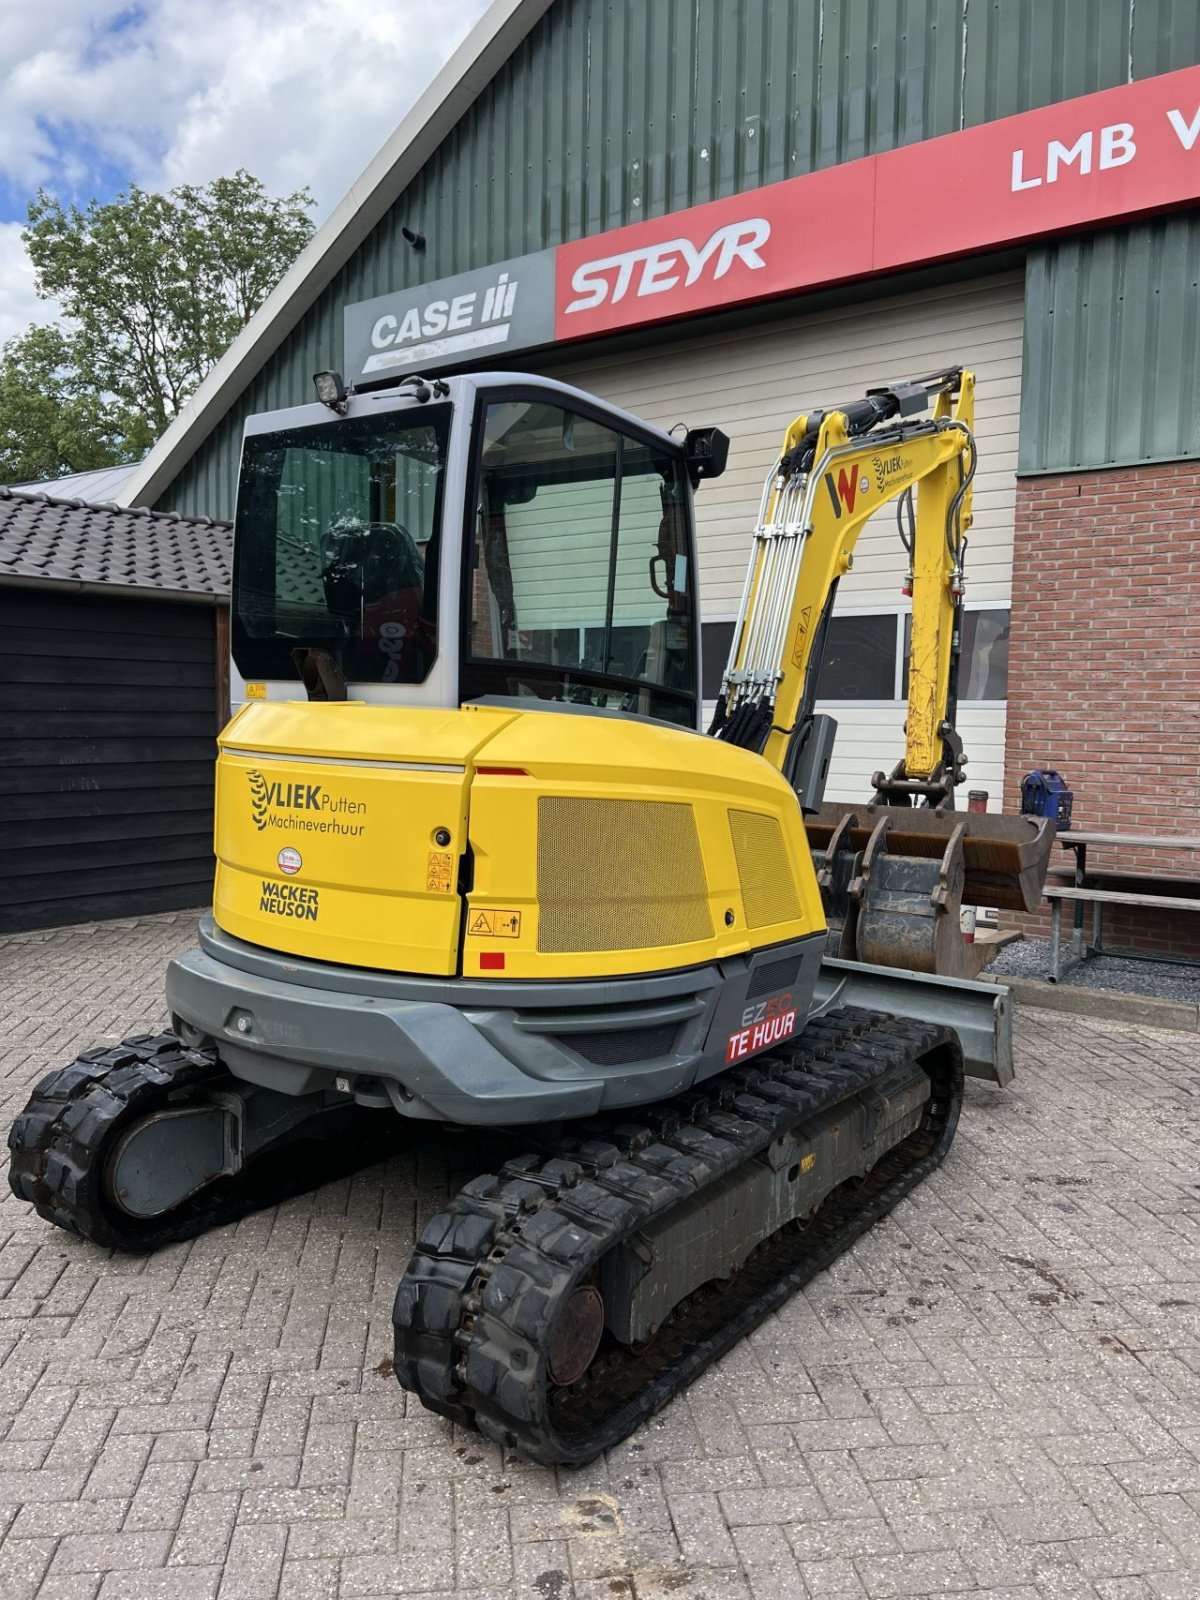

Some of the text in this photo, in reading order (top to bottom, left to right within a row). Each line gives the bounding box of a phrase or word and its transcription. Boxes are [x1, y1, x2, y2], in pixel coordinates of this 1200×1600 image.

[1011, 123, 1137, 192] LMB
[564, 217, 771, 314] STEYR
[371, 292, 477, 348] CASE
[261, 776, 367, 814] VLIEK Putten
[267, 814, 365, 836] Machineverhuur
[259, 897, 318, 921] NEUSON
[262, 881, 319, 905] WACKER
[729, 1011, 795, 1059] TE HUUR
